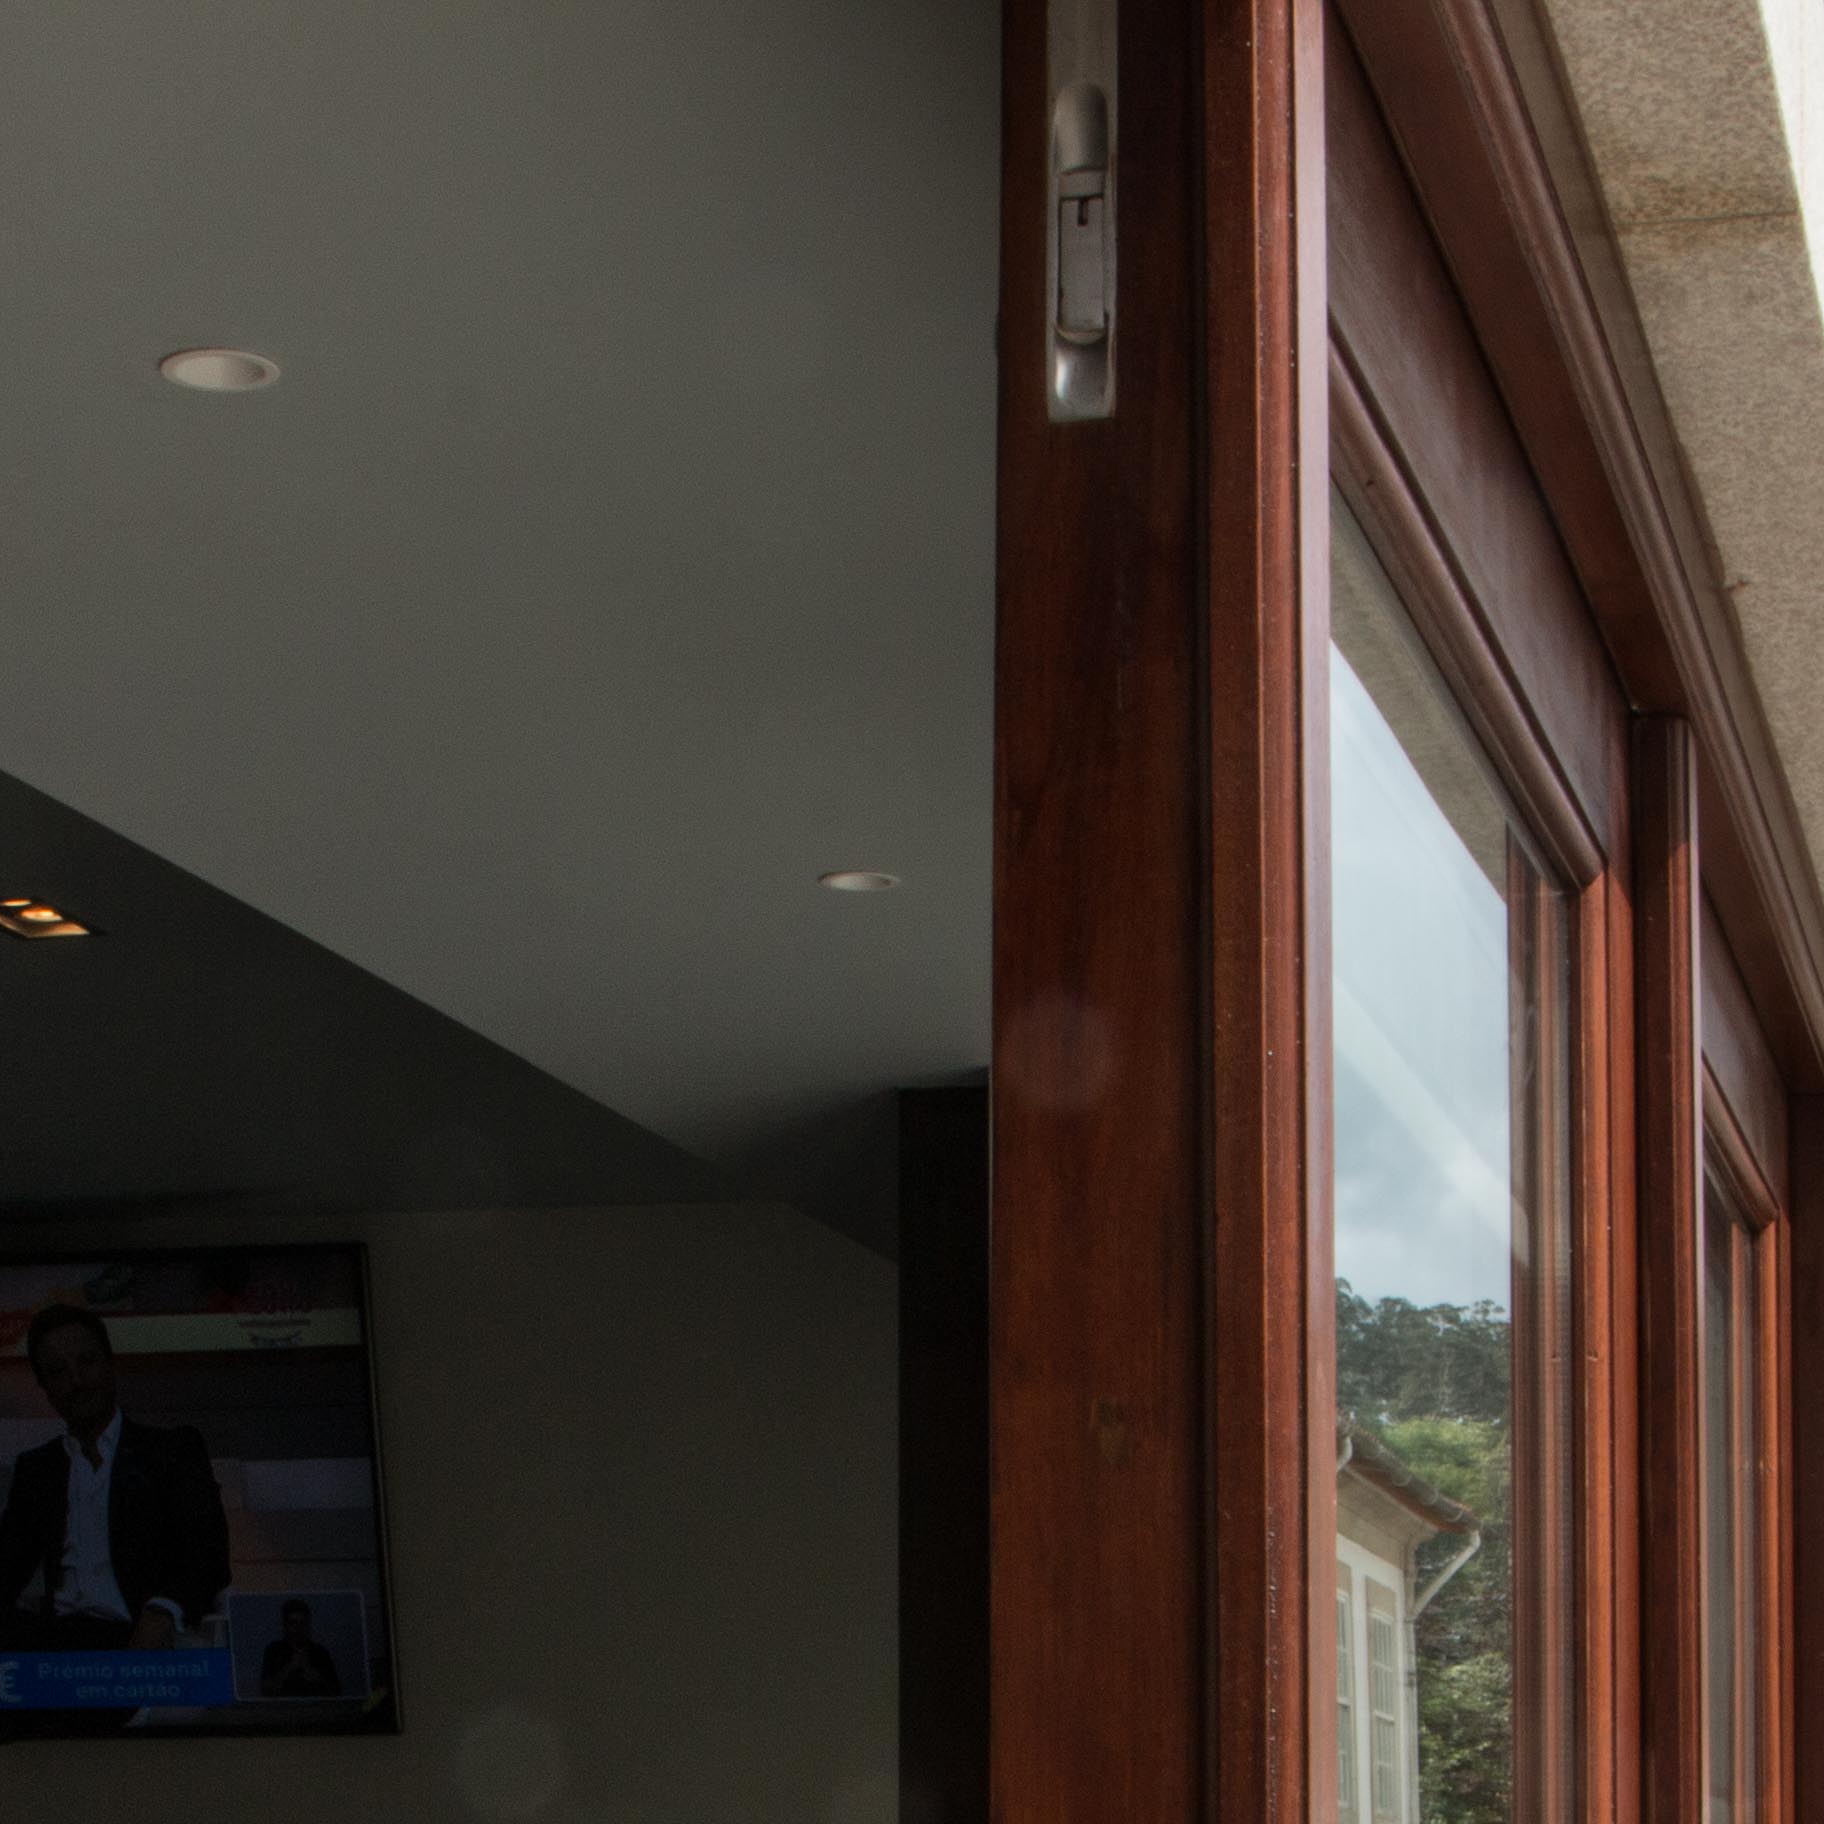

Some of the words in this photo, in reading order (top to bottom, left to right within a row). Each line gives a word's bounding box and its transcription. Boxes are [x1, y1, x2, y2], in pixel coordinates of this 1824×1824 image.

[37, 1661, 115, 1679] Prémio
[119, 1660, 210, 1679] semanal
[76, 1684, 109, 1699] em
